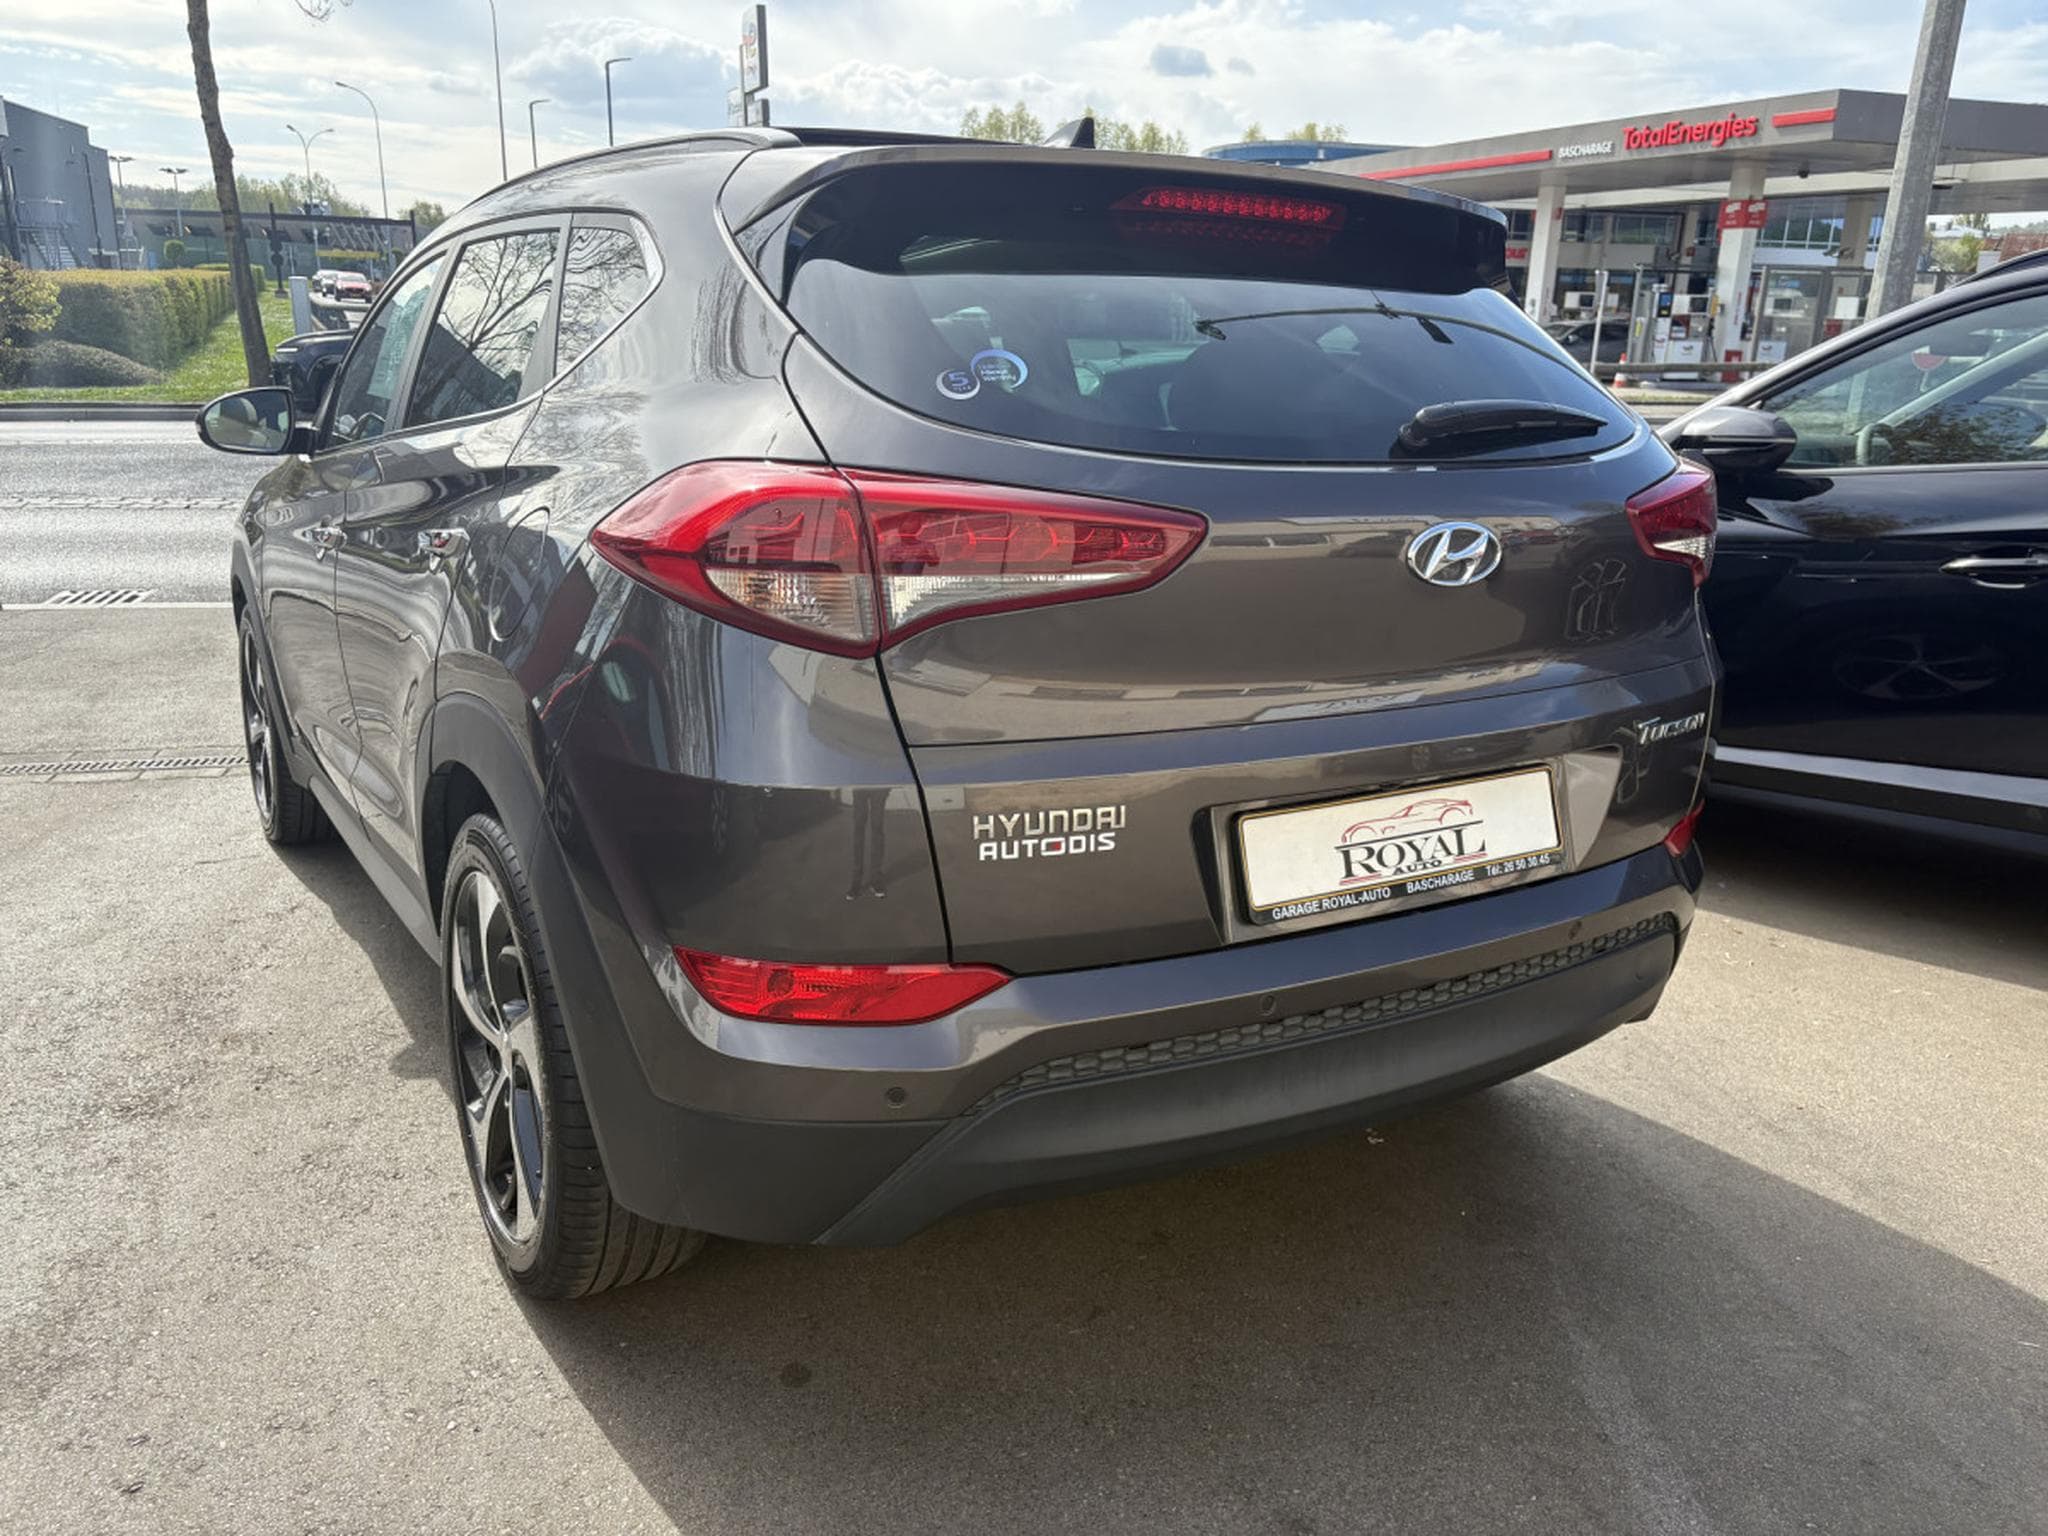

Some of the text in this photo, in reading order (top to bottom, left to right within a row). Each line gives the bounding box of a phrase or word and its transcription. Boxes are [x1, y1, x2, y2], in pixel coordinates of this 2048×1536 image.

[1622, 112, 1759, 152] TotalEnergies
[1559, 141, 1613, 158] BASCHARAGE
[948, 372, 969, 387] 5
[973, 805, 1127, 840] HYUNDAI
[979, 832, 1117, 861] AUTODIS
[1340, 828, 1486, 879] ROYAL
[1393, 860, 1442, 875] AUTO
[1272, 901, 1320, 920] GARAGE
[1322, 887, 1391, 909] ROYAL-AUTO
[1406, 870, 1475, 893] BASCHARAGE
